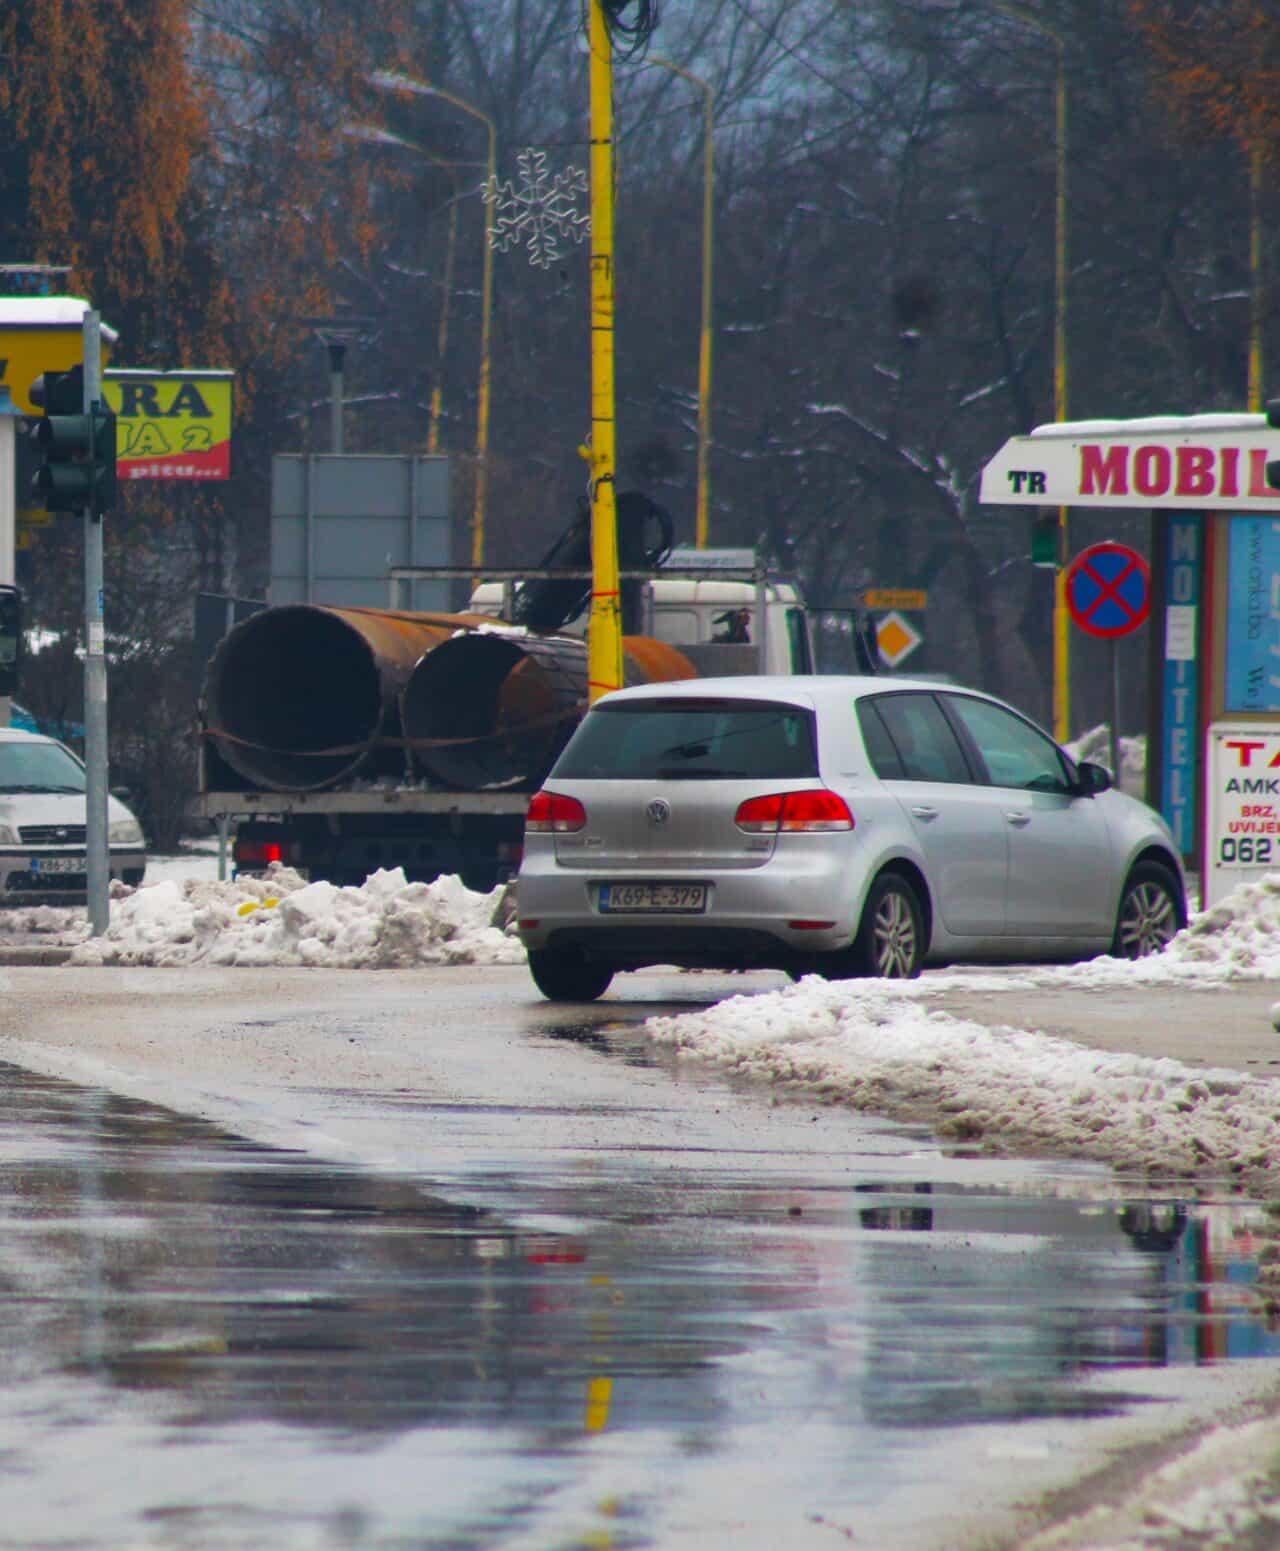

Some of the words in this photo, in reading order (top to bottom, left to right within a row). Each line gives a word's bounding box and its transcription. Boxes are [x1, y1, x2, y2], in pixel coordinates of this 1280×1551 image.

[101, 382, 214, 419] RA
[182, 424, 212, 453] 2
[1008, 470, 1047, 494] TR
[1221, 837, 1272, 863] 062
[611, 886, 702, 906] K69-E-379
